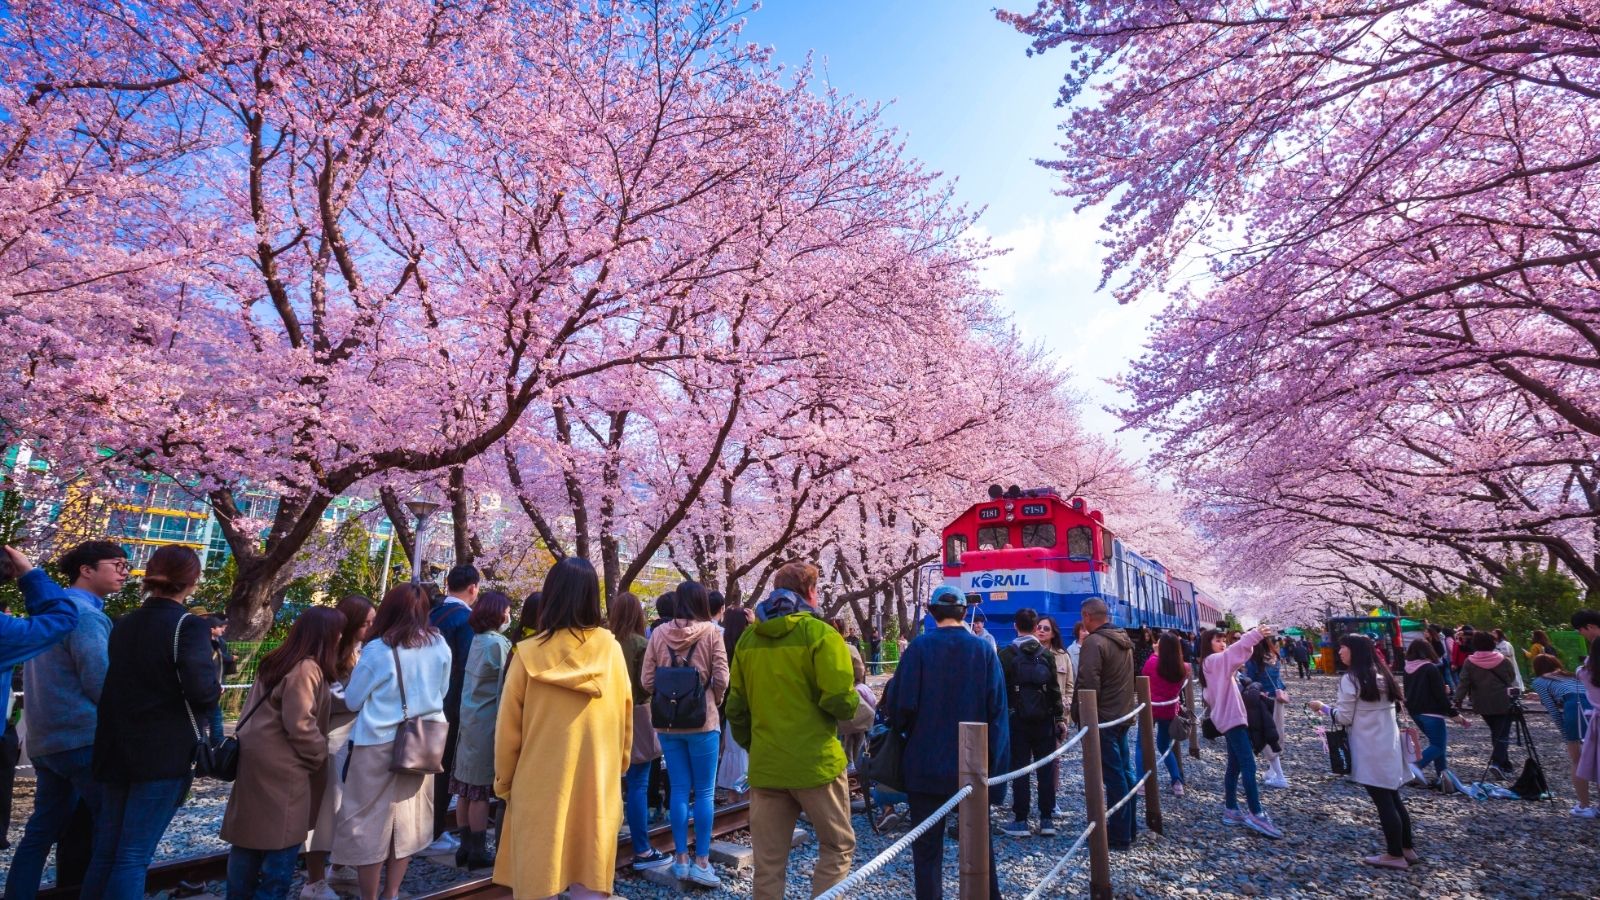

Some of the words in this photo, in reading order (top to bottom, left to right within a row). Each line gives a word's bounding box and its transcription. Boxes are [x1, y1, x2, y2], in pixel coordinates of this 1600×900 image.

[981, 509, 998, 518] 7181
[1024, 505, 1044, 514] 7181
[971, 573, 1030, 588] KORAIL
